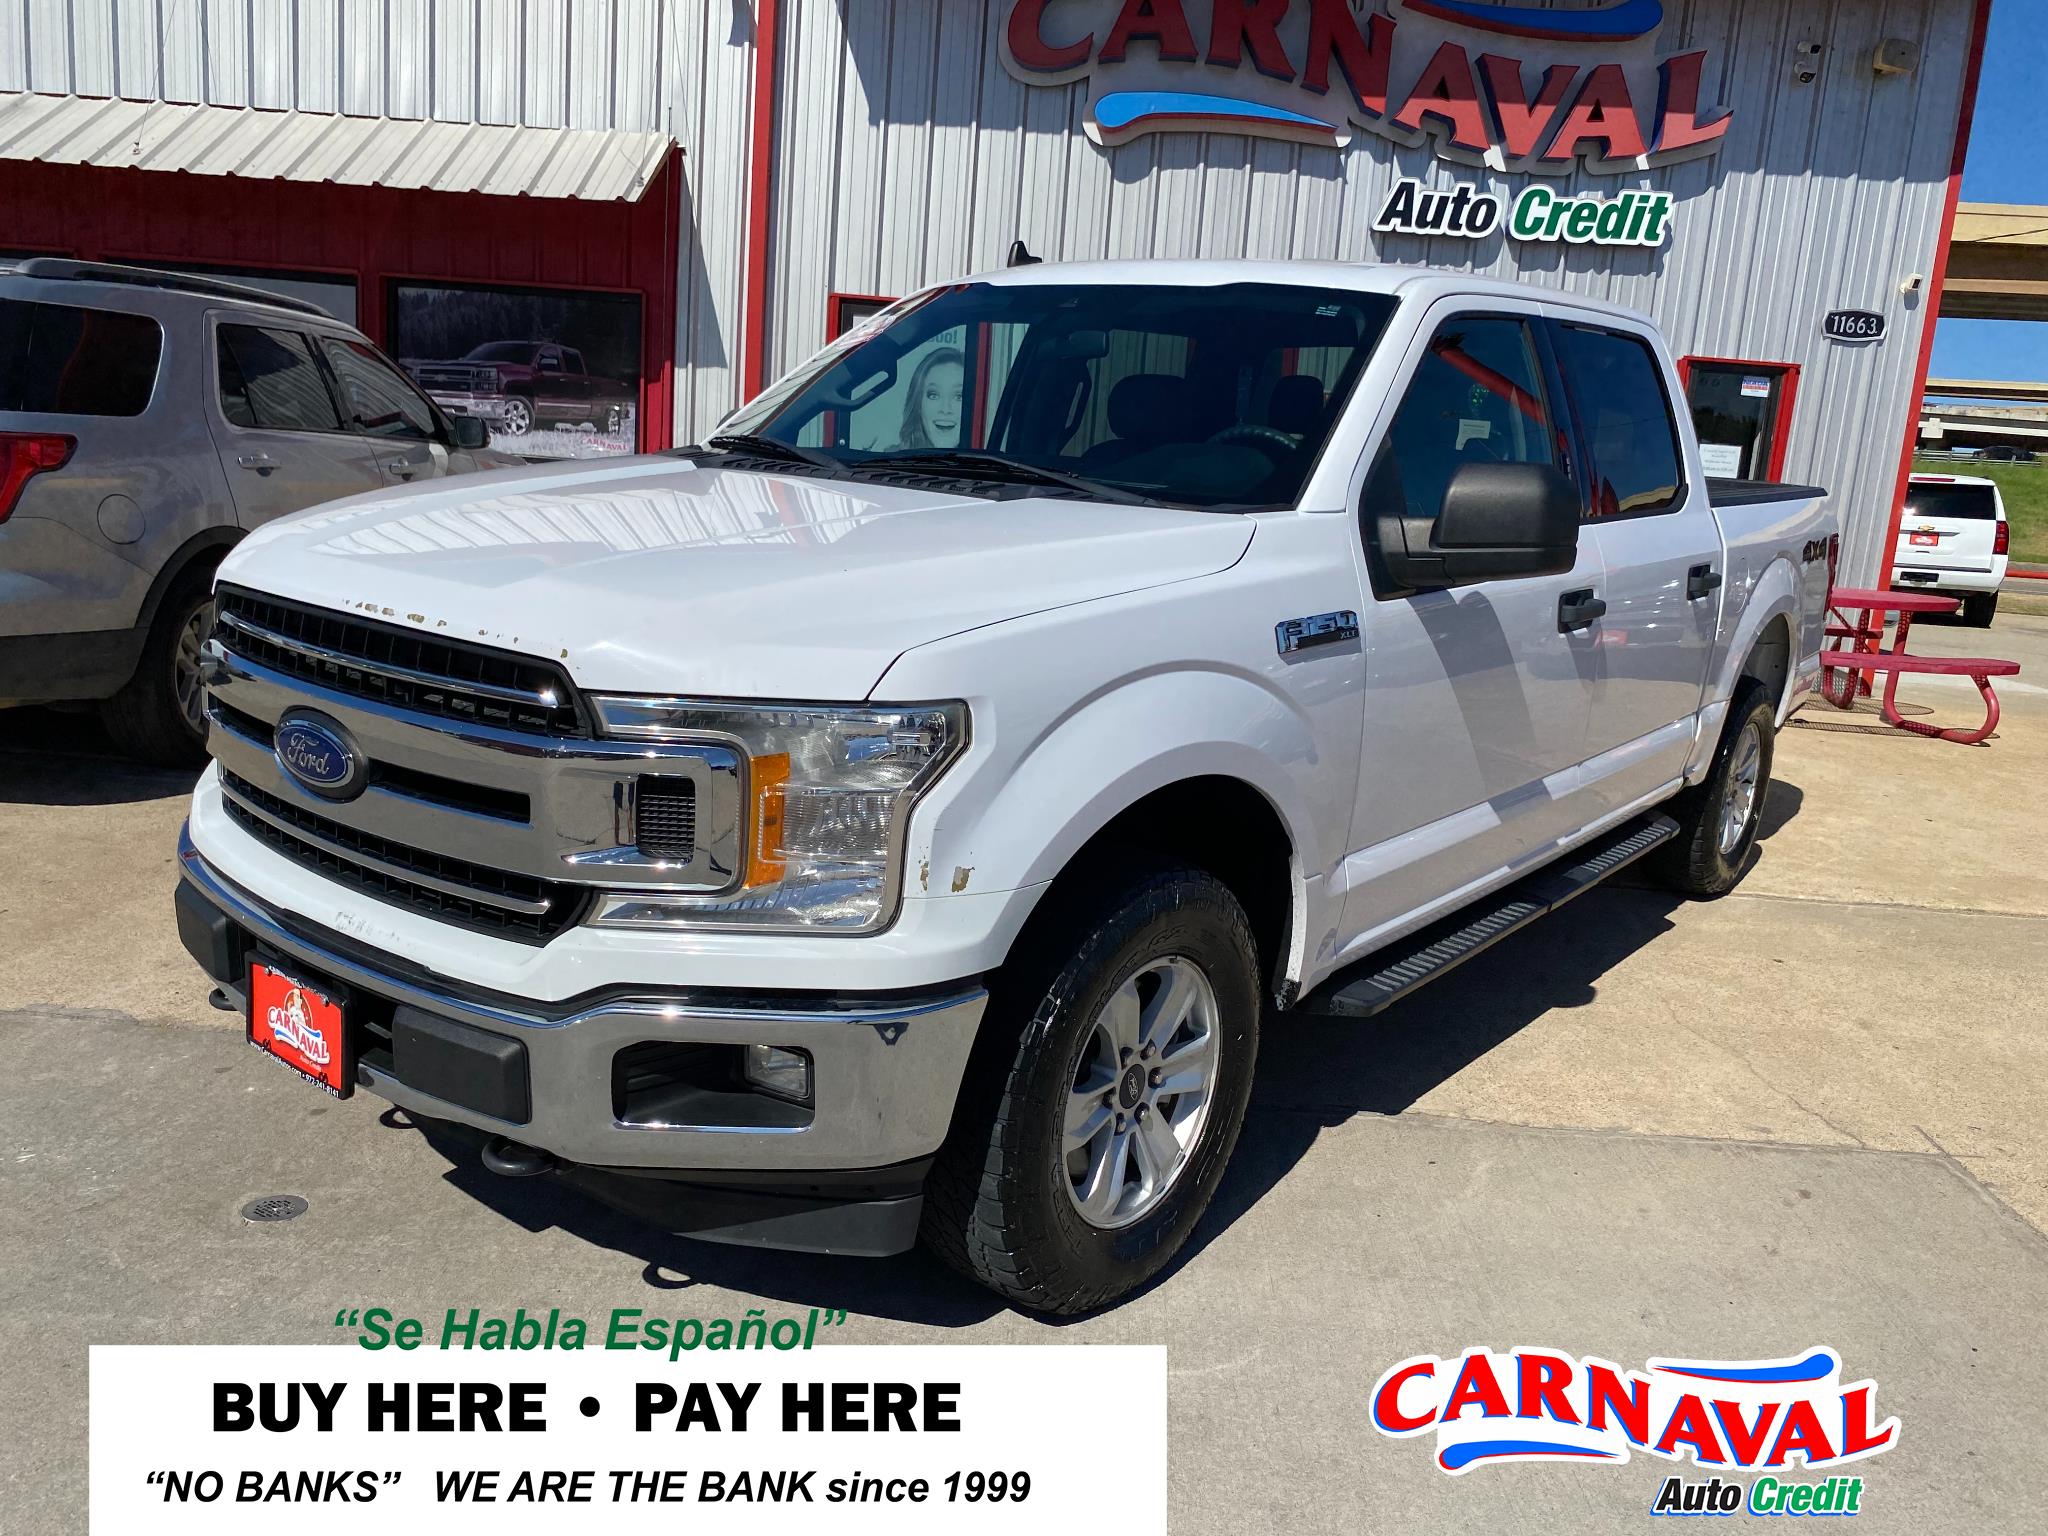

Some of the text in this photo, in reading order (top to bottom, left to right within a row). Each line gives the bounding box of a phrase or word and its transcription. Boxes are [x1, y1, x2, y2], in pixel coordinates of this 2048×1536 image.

[1007, 0, 1733, 162] CARNAVAL
[1377, 181, 1670, 241] Auto Credit
[1832, 315, 1877, 334] 11663
[287, 732, 330, 775] Ford
[267, 1007, 329, 1059] CARNAVAL
[305, 1074, 339, 1098] 972-241-8141
